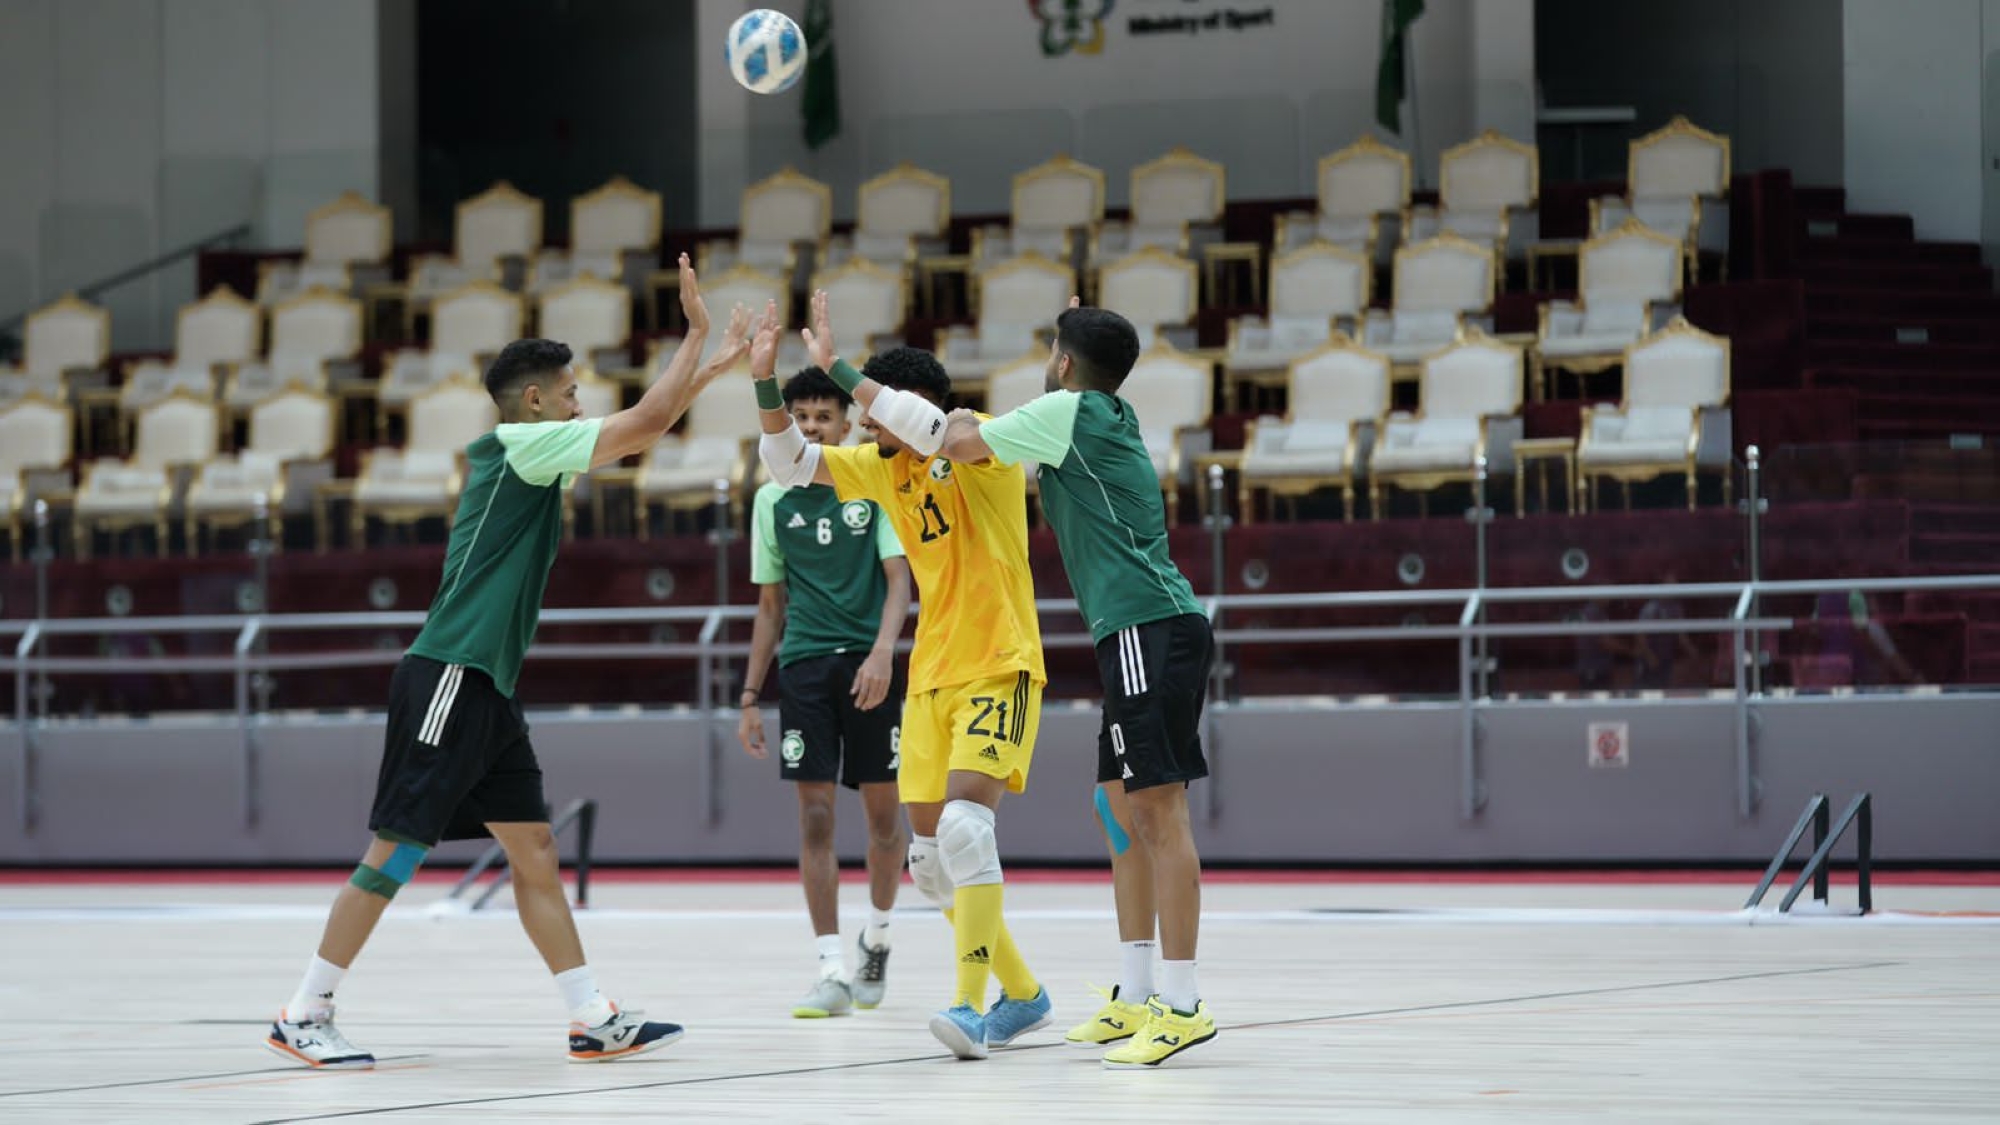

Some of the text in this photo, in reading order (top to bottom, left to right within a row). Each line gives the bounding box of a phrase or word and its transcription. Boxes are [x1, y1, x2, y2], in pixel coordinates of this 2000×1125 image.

[1223, 6, 1274, 31] Sport
[817, 517, 832, 545] 6
[967, 697, 1007, 741] 21
